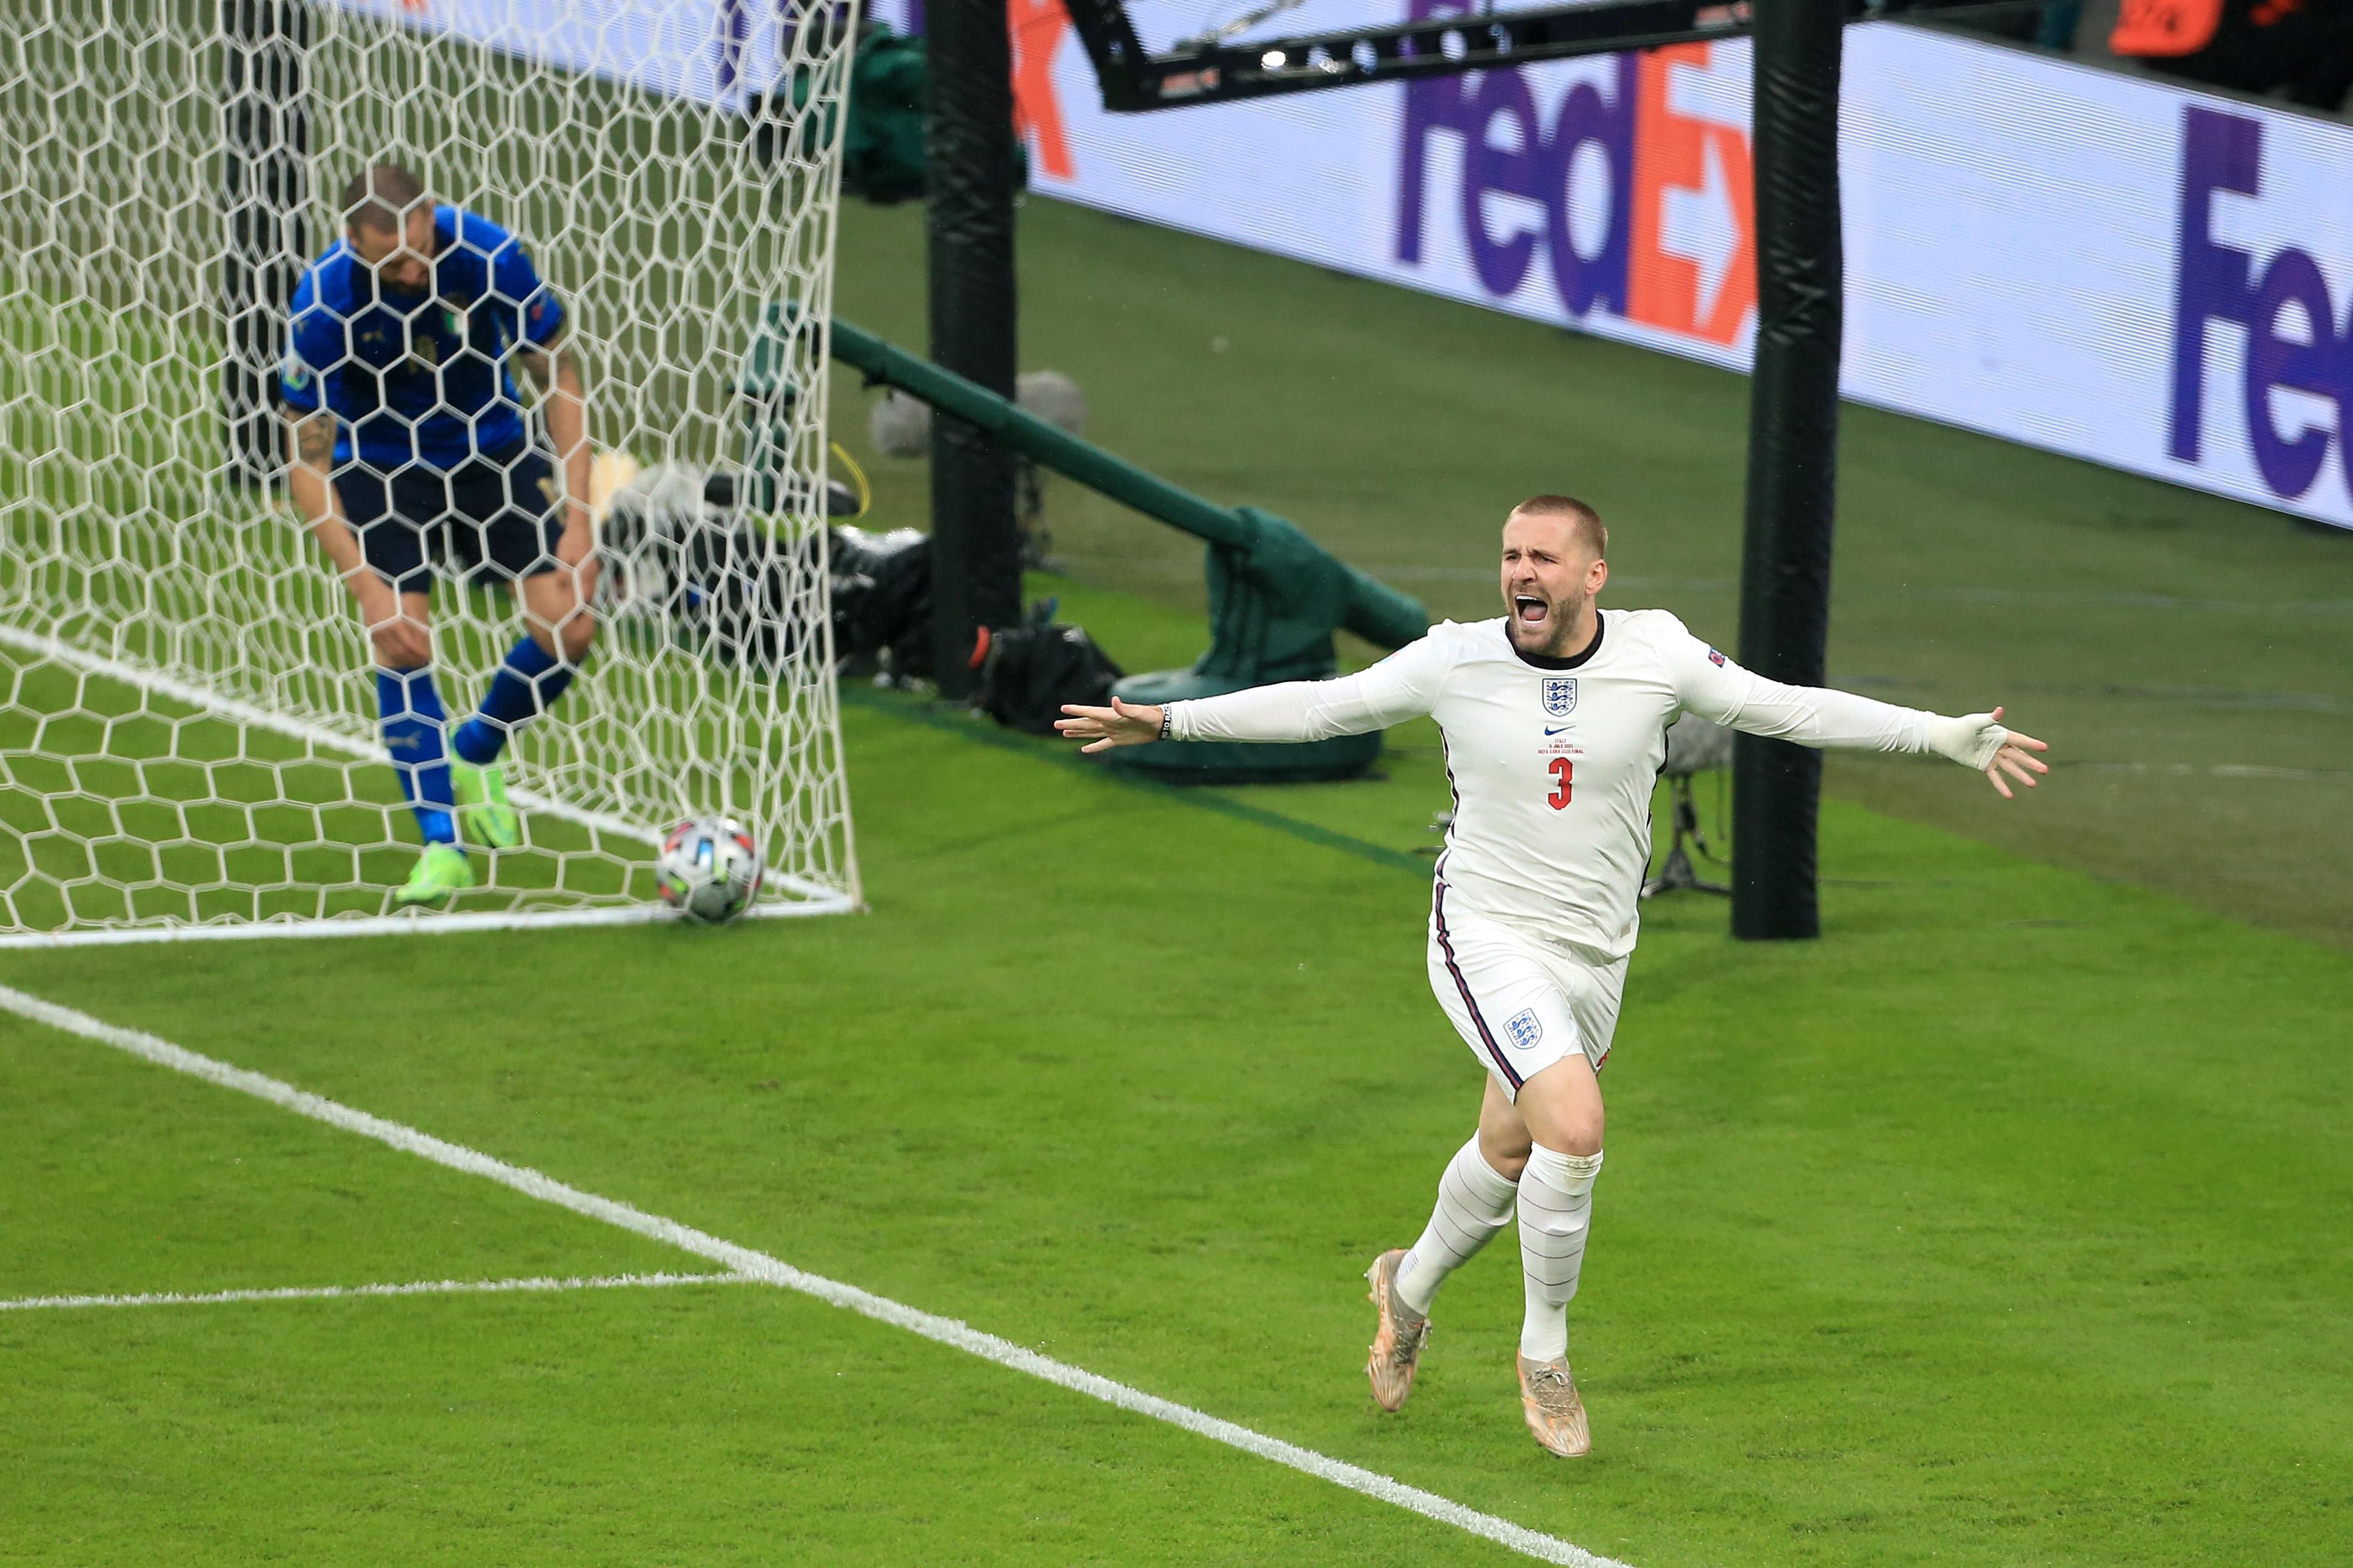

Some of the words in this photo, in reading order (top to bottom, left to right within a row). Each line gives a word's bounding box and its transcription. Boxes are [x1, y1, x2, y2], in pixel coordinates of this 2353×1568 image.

[2169, 105, 2353, 505] Fe
[1163, 722, 1170, 731] TO
[1548, 757, 1572, 810] 3
